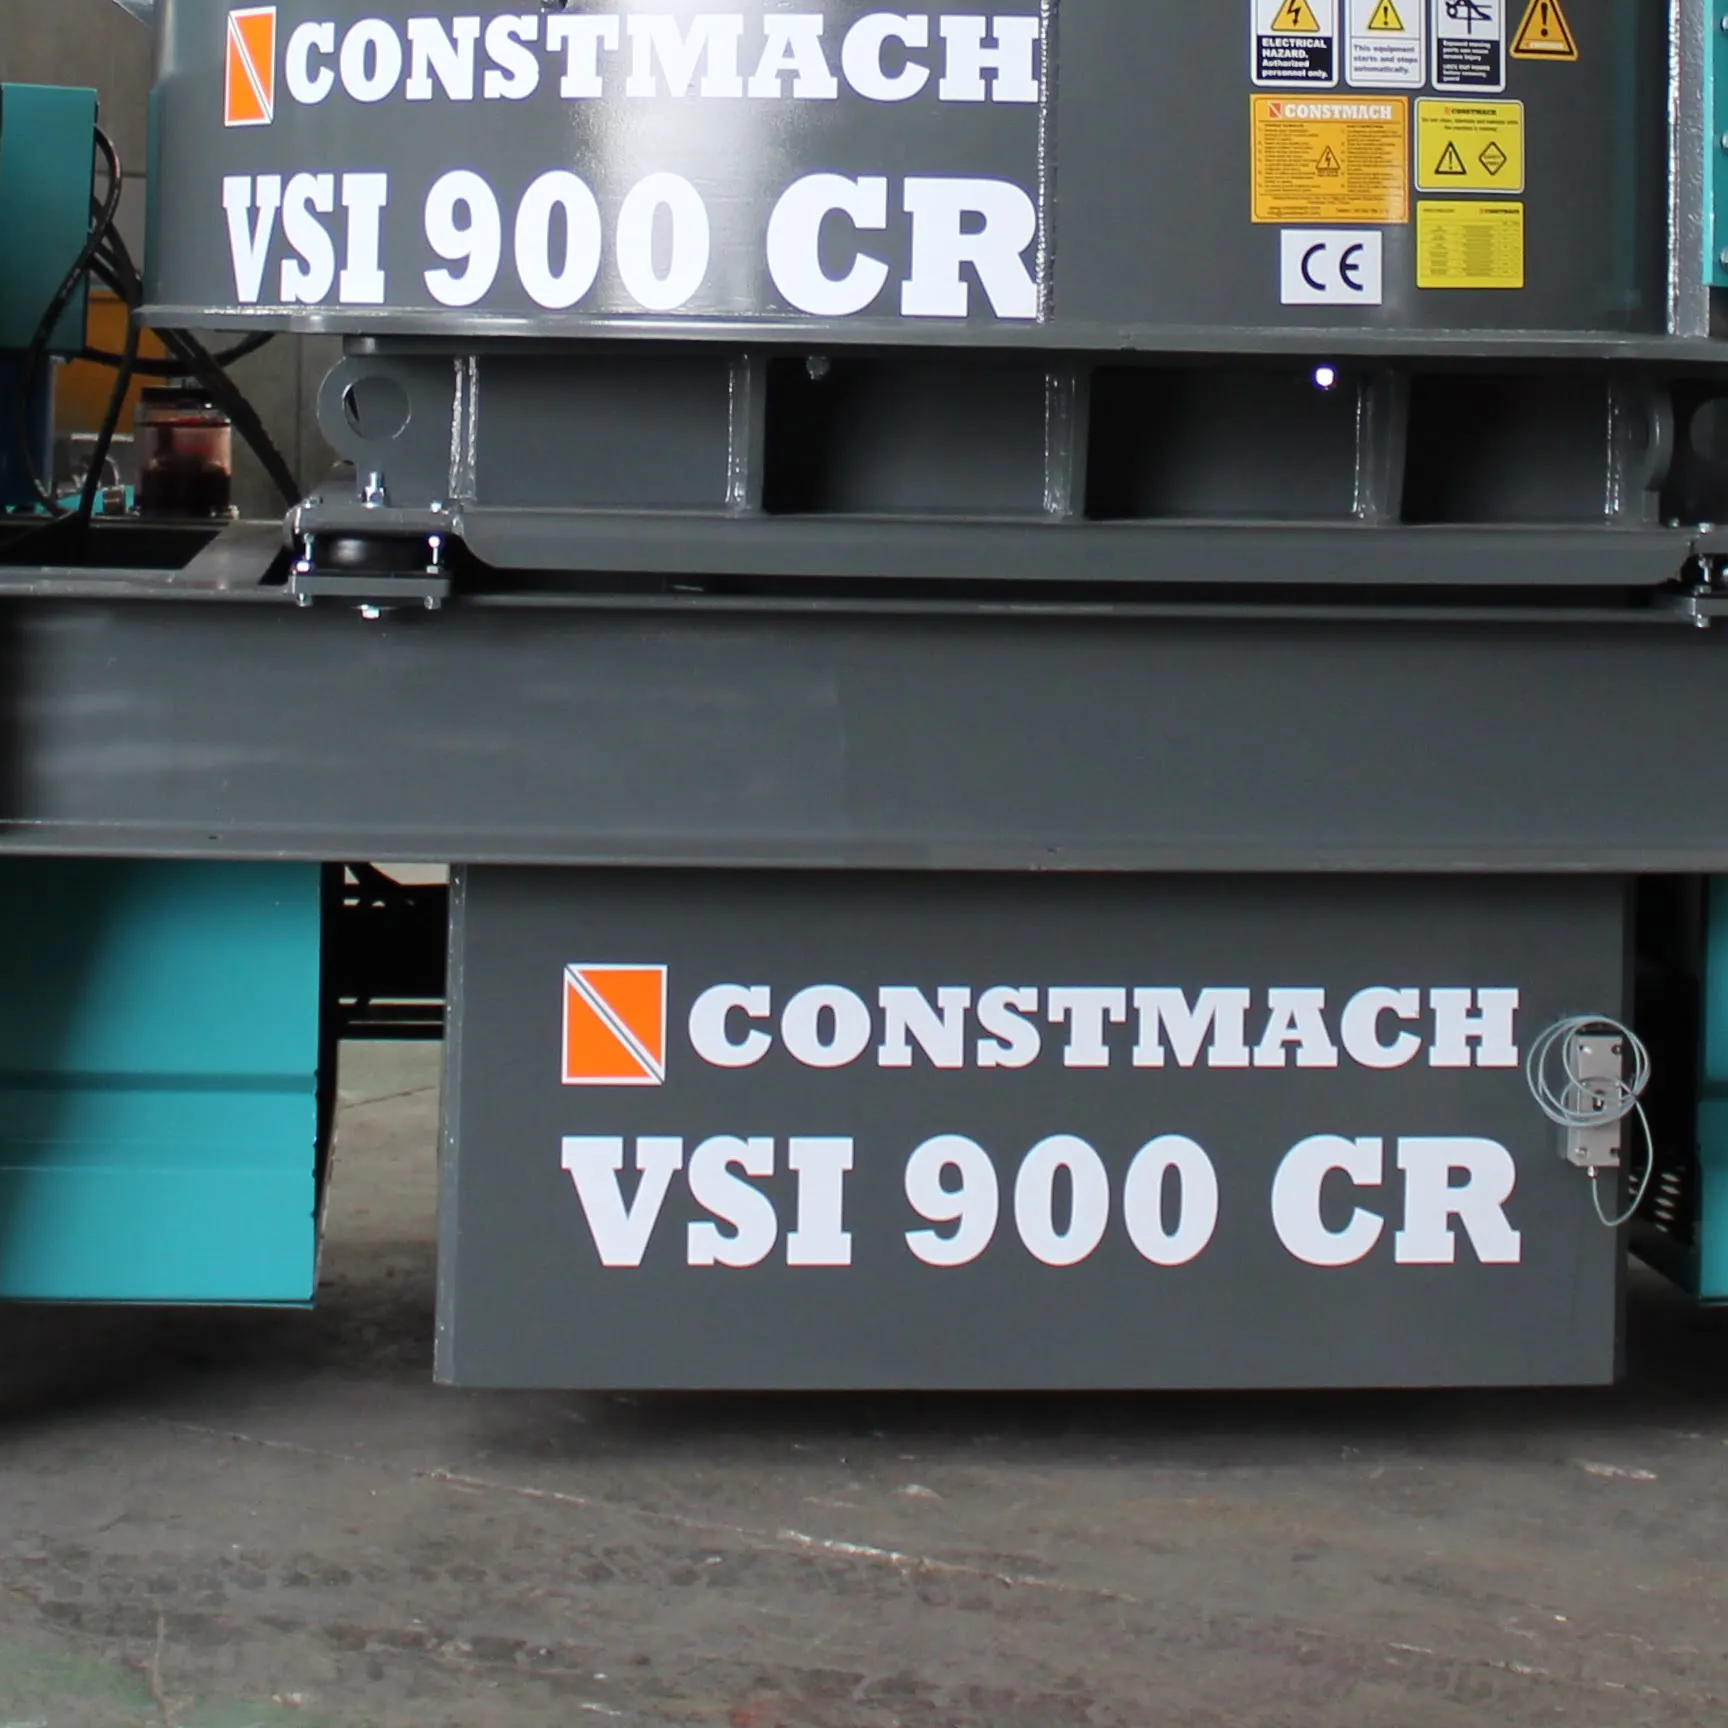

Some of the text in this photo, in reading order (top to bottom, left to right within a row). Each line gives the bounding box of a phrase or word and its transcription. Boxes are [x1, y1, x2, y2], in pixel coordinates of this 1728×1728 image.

[284, 11, 1040, 104] CONSTMACH
[1261, 37, 1328, 49] ELECTRICAL
[1261, 48, 1309, 59] HAZARD.
[1353, 44, 1371, 52] This
[1284, 103, 1393, 120] CONSTMACH
[222, 169, 1039, 319] VSI 900 CR
[688, 983, 1520, 1070] CONSTMACH
[560, 1132, 1522, 1268] VSI 900 CR
